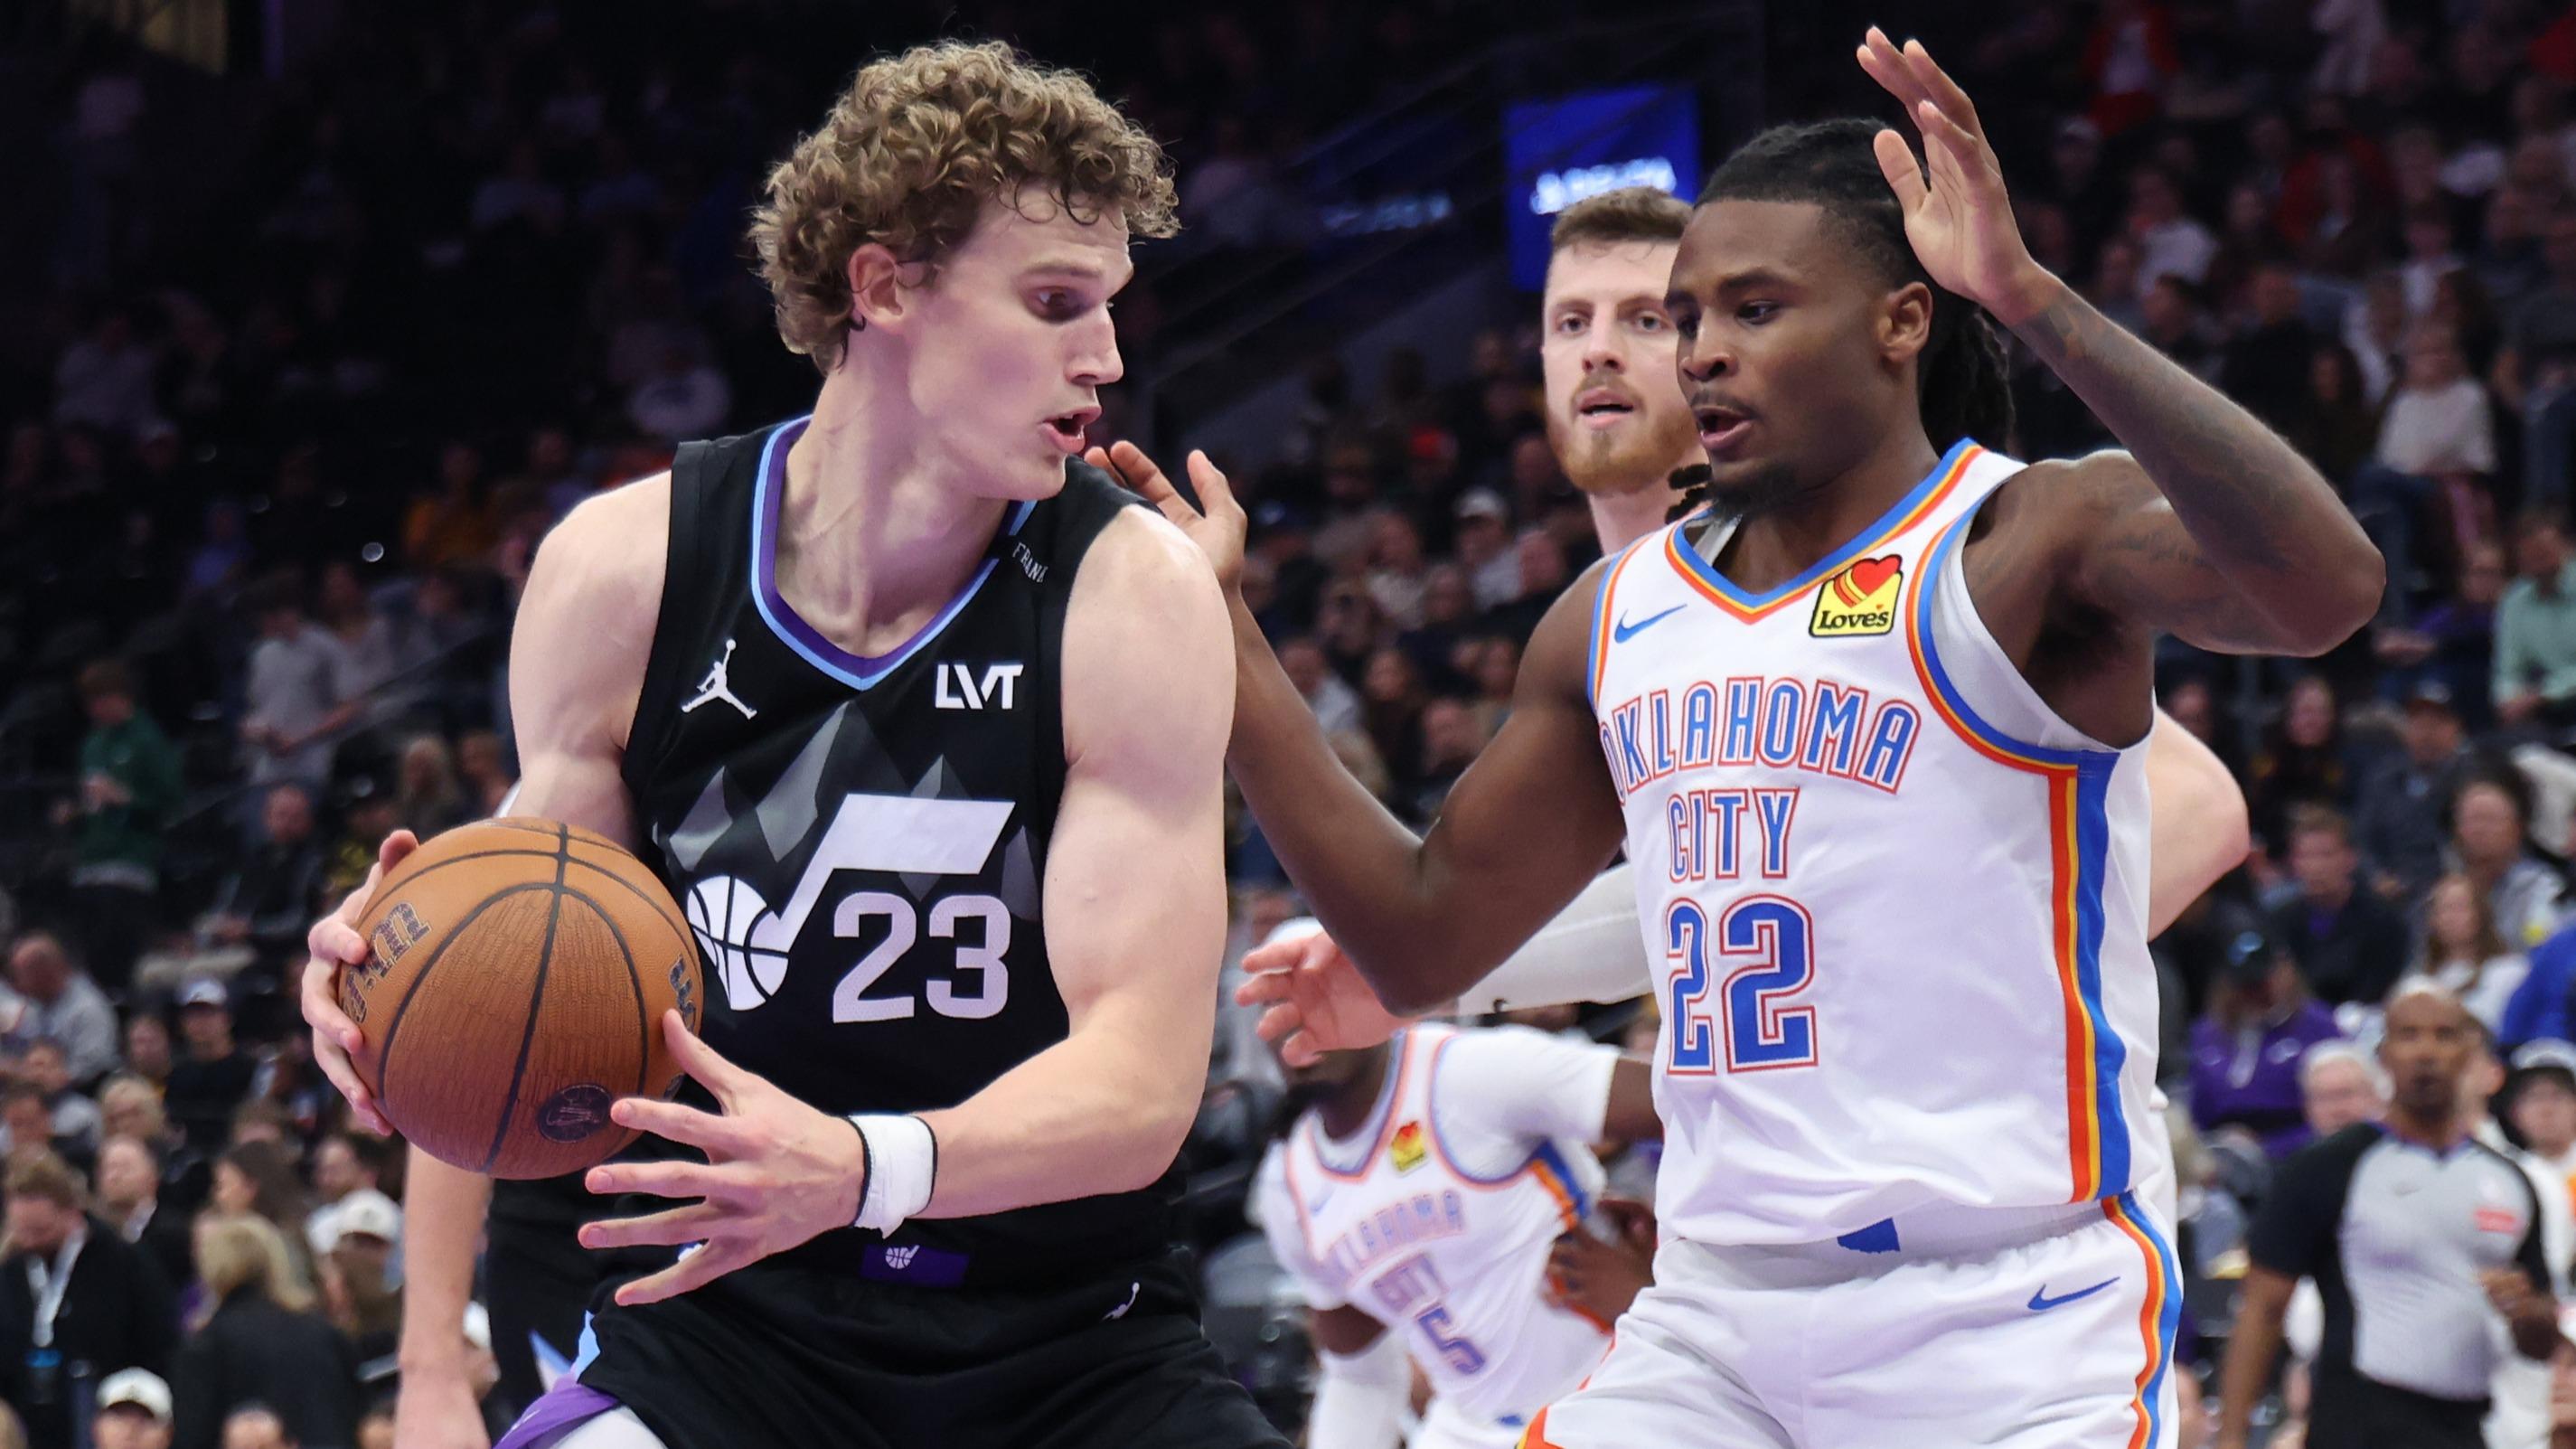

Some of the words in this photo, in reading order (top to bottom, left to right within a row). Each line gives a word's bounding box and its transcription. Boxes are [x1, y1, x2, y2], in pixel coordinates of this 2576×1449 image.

[935, 664, 1023, 710] LVT
[1599, 676, 1921, 806] OKLAHOMA
[1667, 787, 1799, 882] CITY
[832, 891, 1011, 1023] 23
[1667, 894, 1819, 1076] 22
[1415, 1302, 1488, 1376] 5
